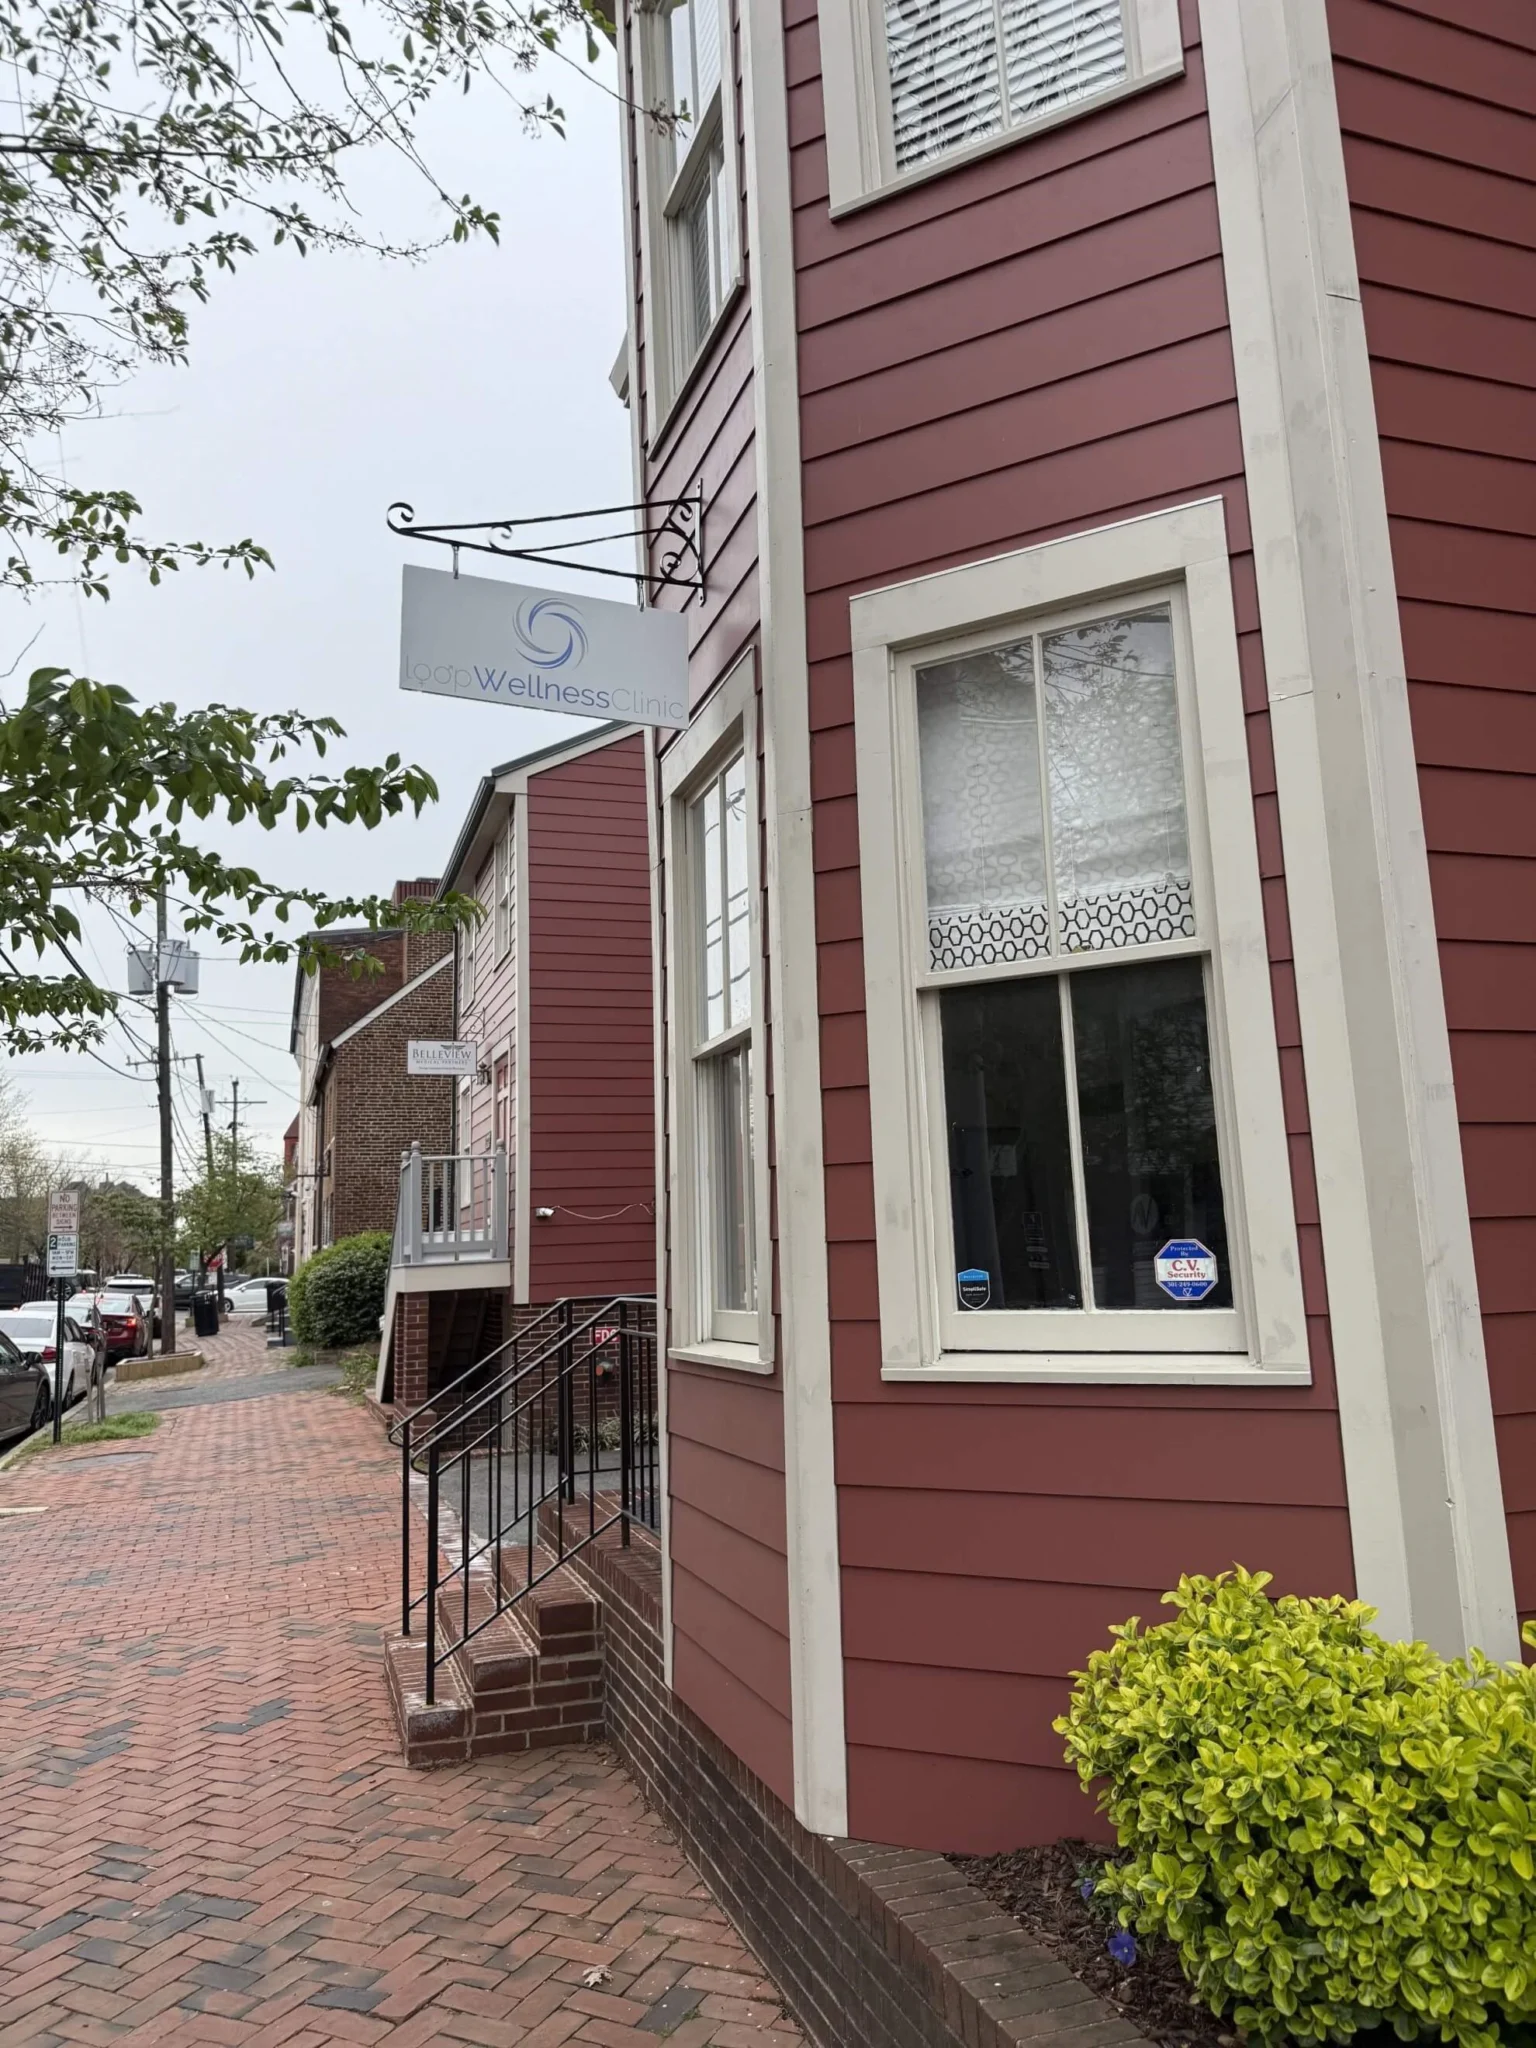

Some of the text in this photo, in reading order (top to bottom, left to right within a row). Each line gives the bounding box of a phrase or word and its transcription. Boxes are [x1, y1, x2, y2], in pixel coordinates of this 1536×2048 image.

[412, 1048, 472, 1059] BELLEVIEW
[60, 1194, 71, 1203] NO
[51, 1203, 77, 1212] PARKING
[50, 1237, 57, 1248] 2
[1172, 1259, 1200, 1271] C.V.
[1167, 1270, 1206, 1279] Security
